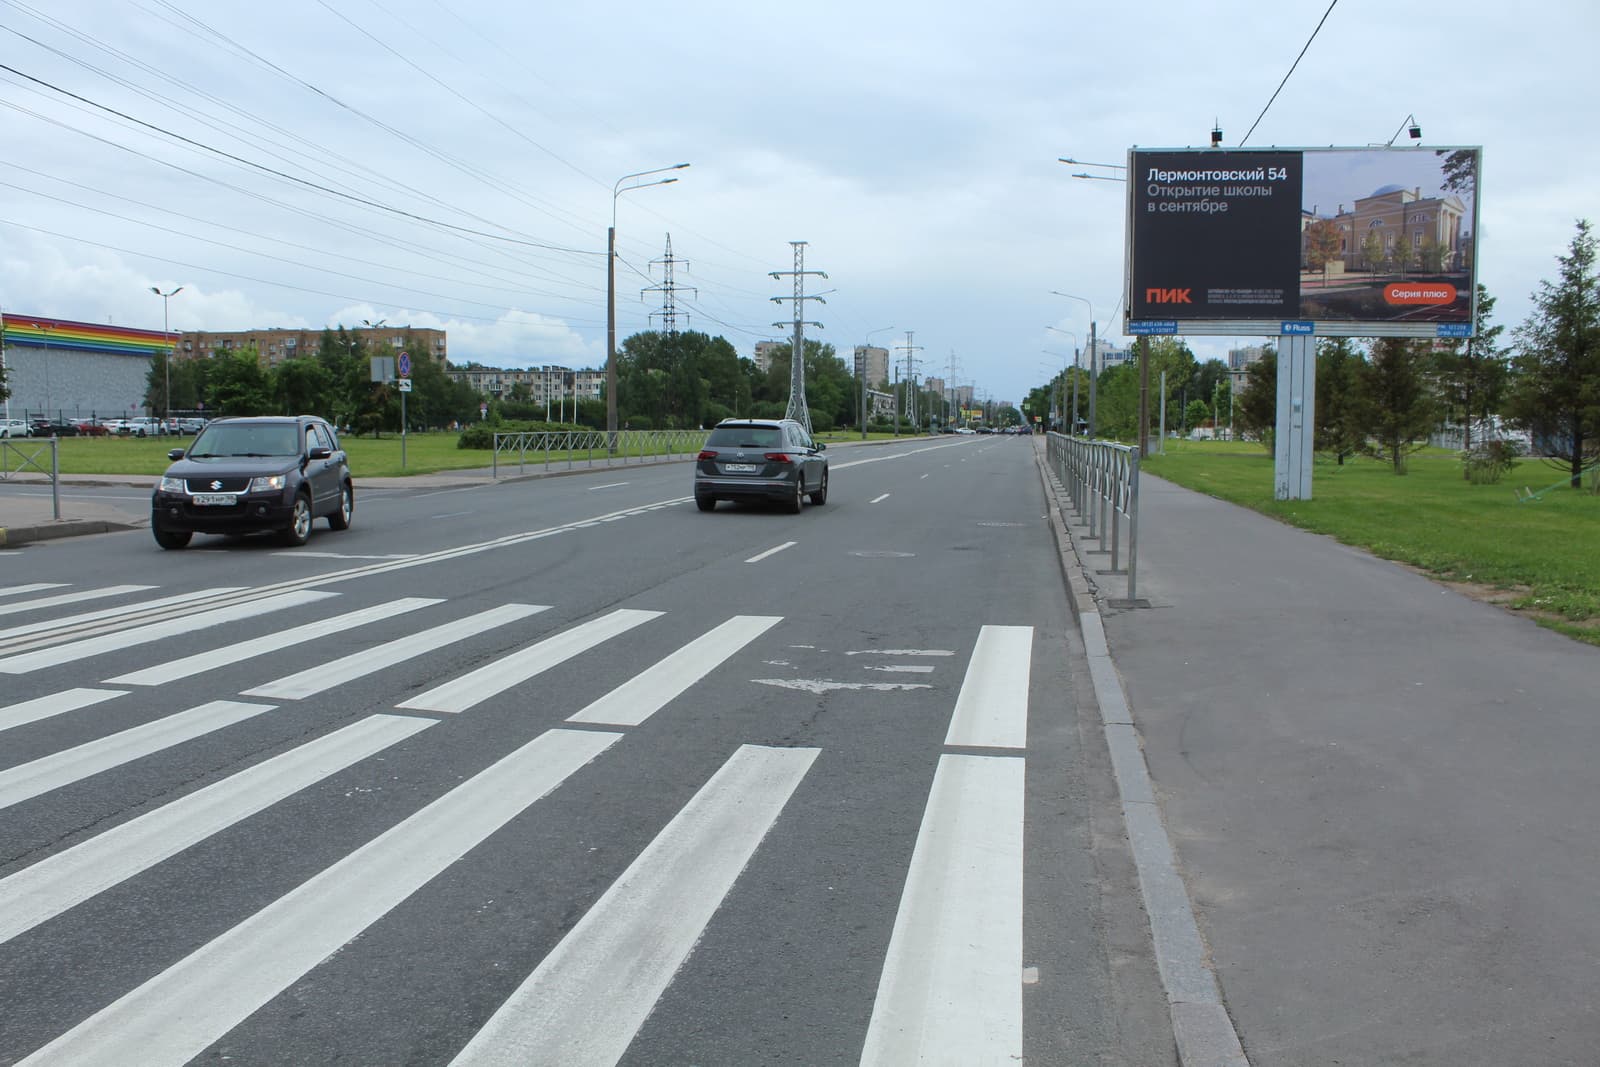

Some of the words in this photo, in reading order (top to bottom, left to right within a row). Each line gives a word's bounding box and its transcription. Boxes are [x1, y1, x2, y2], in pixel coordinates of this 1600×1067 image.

[1148, 168, 1265, 183] Лермонтовский
[1268, 168, 1287, 180] 54
[1148, 184, 1220, 199] Открытие
[1224, 186, 1272, 196] школы
[1148, 202, 1155, 212] в
[1159, 199, 1228, 214] сентябре
[1146, 288, 1192, 304] ПИК
[1391, 290, 1421, 299] Серия
[1423, 290, 1447, 298] плюс
